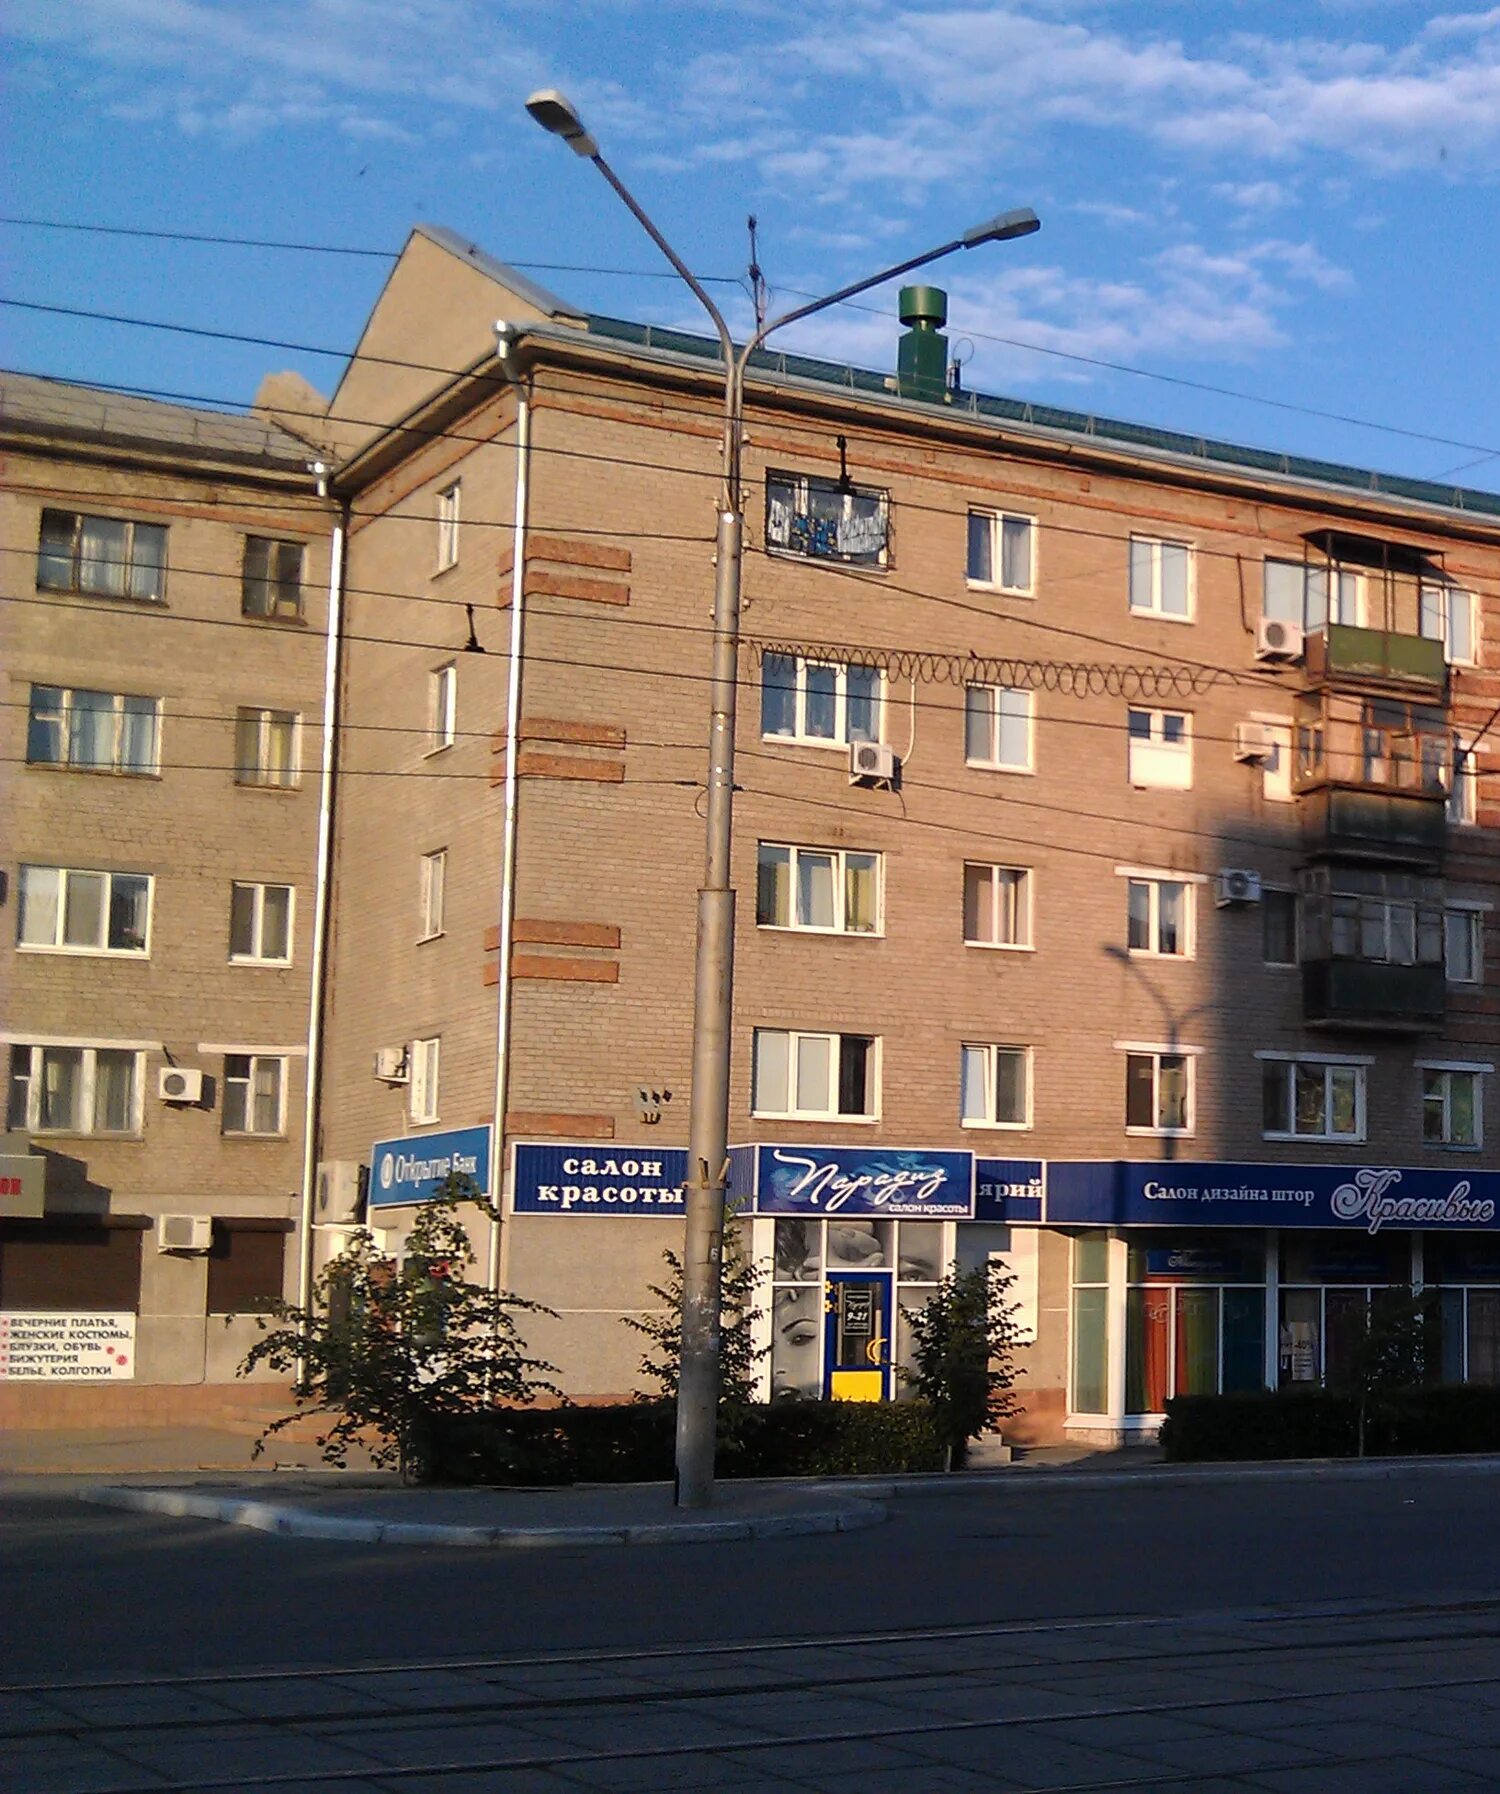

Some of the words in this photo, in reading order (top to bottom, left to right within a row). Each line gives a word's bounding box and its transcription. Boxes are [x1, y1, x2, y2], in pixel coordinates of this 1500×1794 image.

[563, 1158, 662, 1177] салон
[773, 1149, 948, 1211] Парадиз
[537, 1185, 684, 1209] красоты
[976, 1178, 1043, 1203] ярий
[1144, 1181, 1199, 1200] Салон
[1201, 1184, 1269, 1203] дизайна
[1271, 1189, 1315, 1207] штор
[1330, 1168, 1495, 1235] Красивые
[888, 1204, 922, 1213] салон
[923, 1204, 969, 1215] красоты
[10, 1318, 67, 1328] ВЕЧЕРНИЕ
[71, 1319, 118, 1329] ПЛАТЬЯ,
[10, 1330, 65, 1340] ЖЕНСКИЕ
[69, 1330, 133, 1340] КОСТЮМЫ,
[10, 1342, 58, 1352] БЛУЗКИ,
[63, 1342, 102, 1352] ОБУВЬ
[9, 1354, 79, 1364] БИЖУТЕРИЯ
[51, 1366, 112, 1376] КОЛГОТКИ
